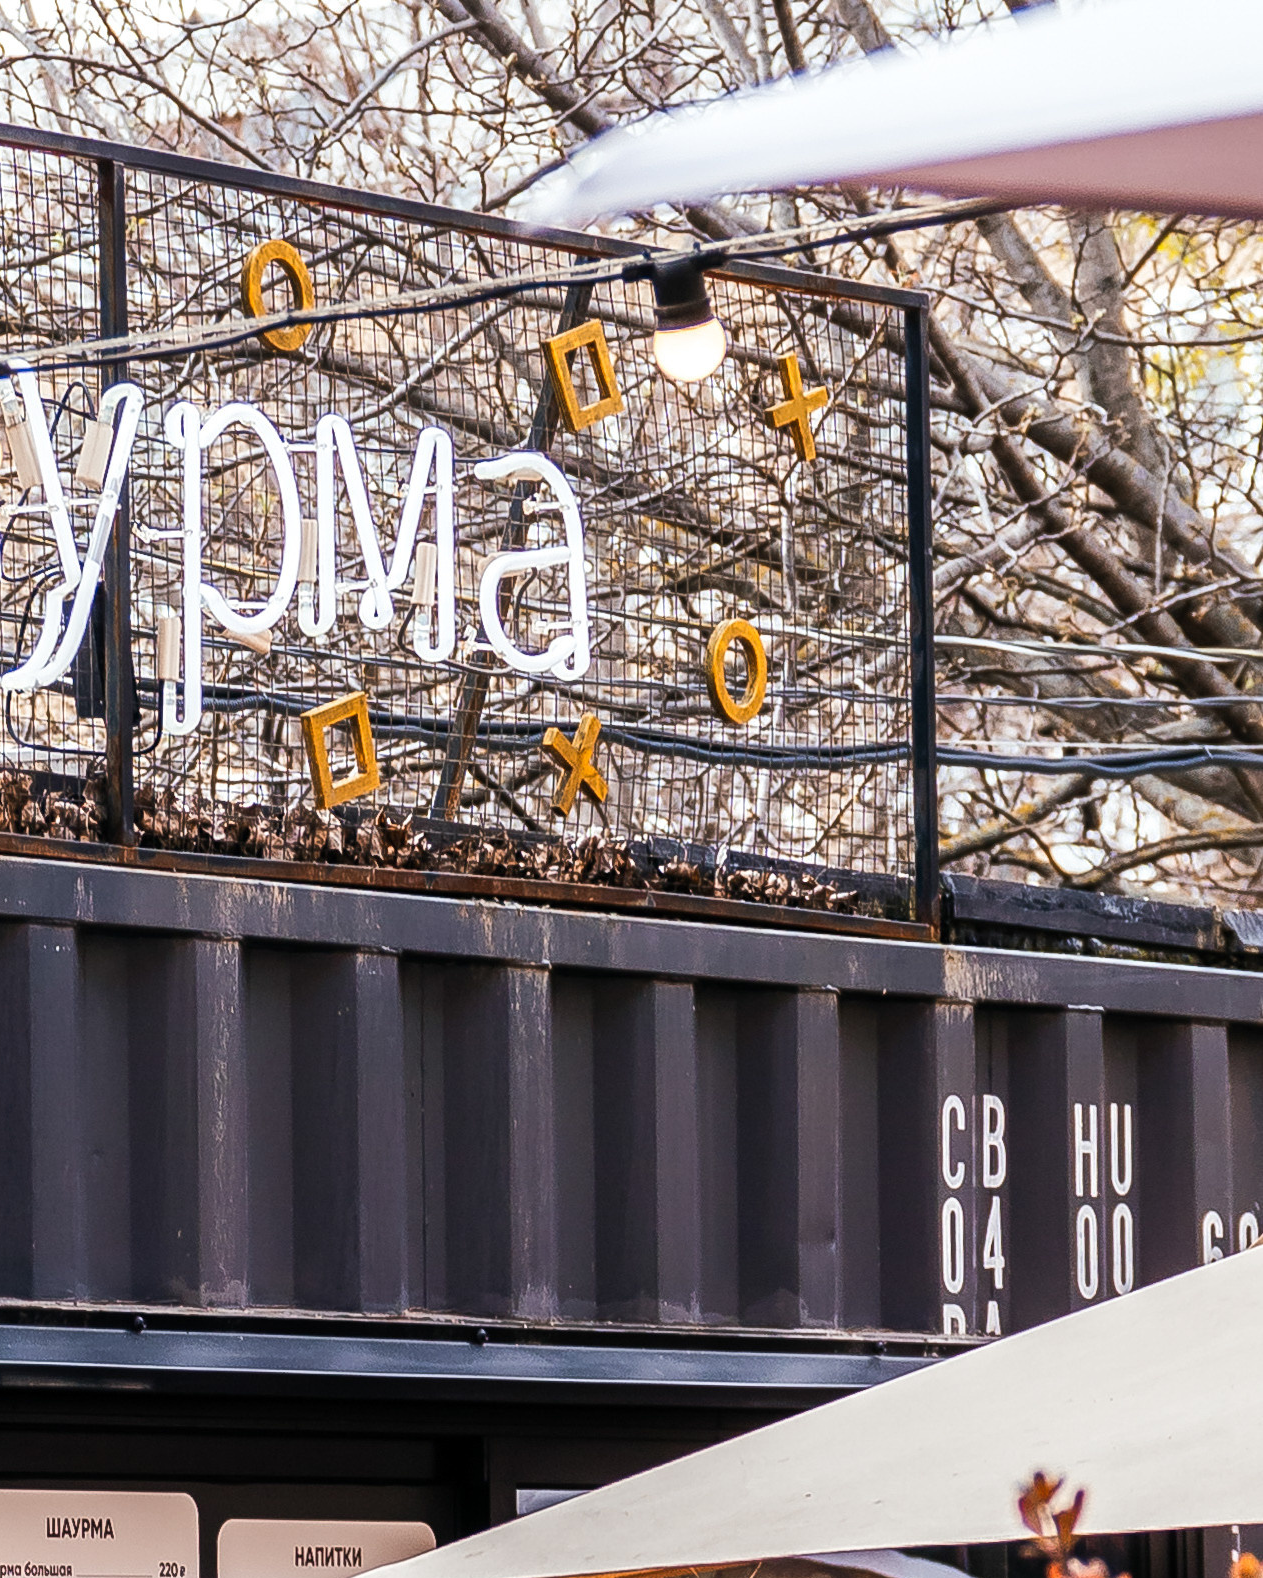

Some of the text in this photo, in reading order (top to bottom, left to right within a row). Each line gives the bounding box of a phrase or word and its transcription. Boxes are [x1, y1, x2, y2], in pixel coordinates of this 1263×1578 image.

[941, 1094, 1132, 1198] CB HU
[46, 1517, 114, 1539] ШАУРМА
[294, 1546, 362, 1568] НАПИТКИ
[24, 1562, 72, 1577] большая
